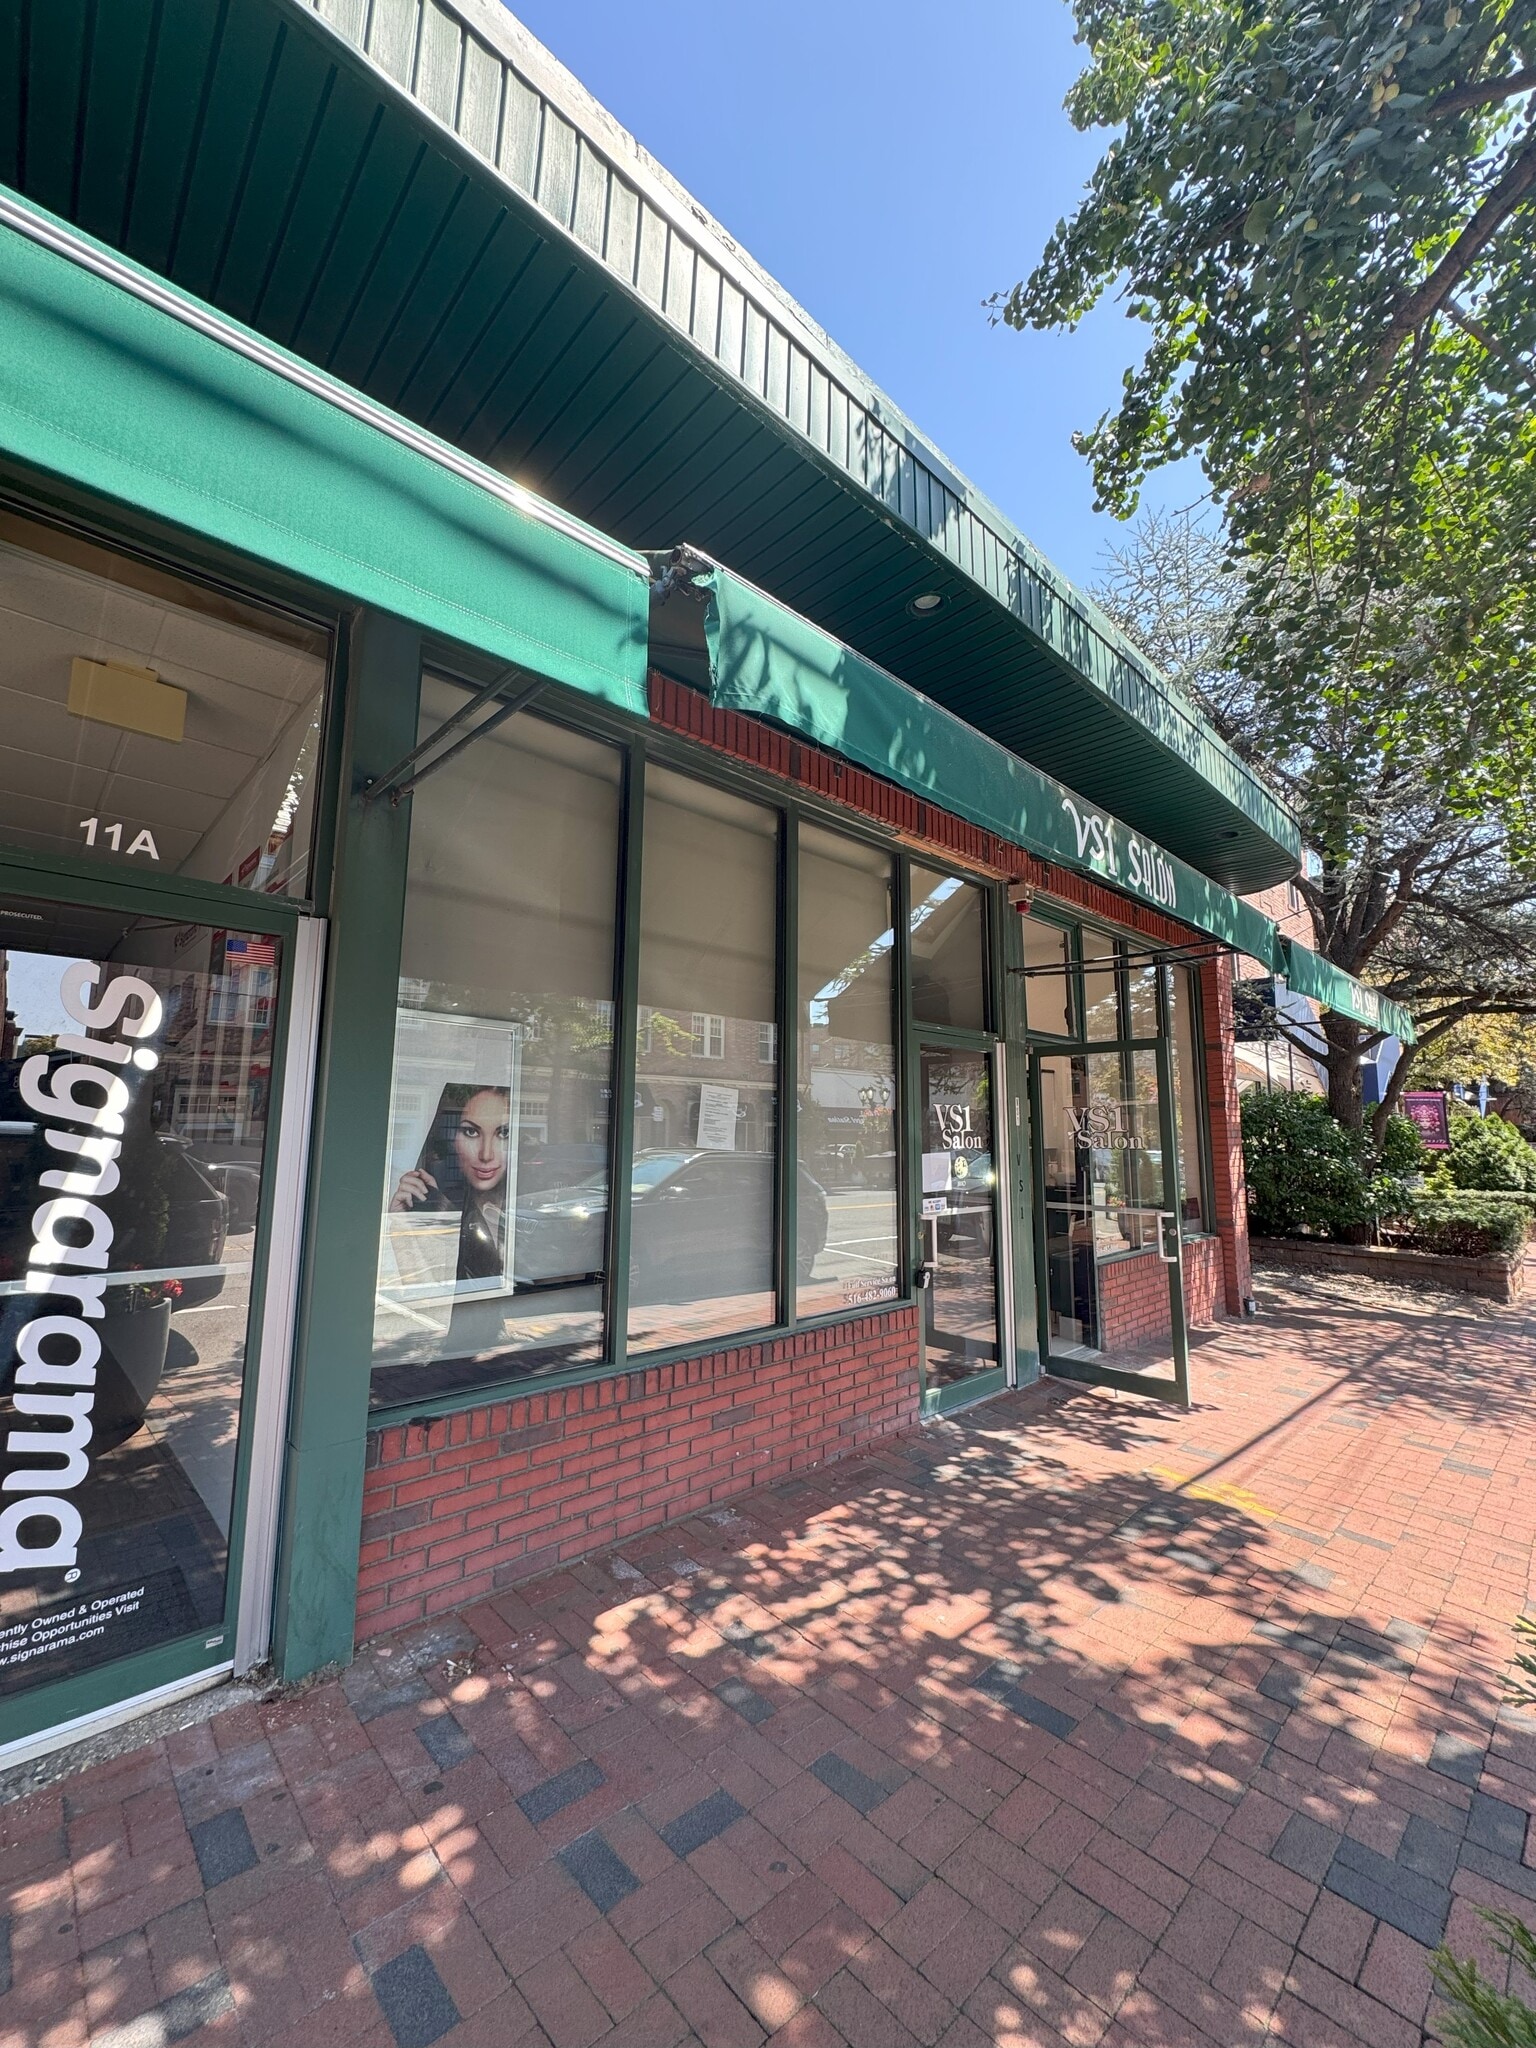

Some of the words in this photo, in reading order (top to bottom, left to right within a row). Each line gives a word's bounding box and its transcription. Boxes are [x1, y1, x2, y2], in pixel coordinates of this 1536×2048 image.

[79, 817, 160, 861] 11A
[1127, 839, 1176, 909] SALON
[0, 909, 44, 921] PROSECUTED.
[932, 1103, 974, 1133] VS1
[1063, 1105, 1128, 1132] VS1
[942, 1129, 983, 1150] Salon
[1077, 1130, 1145, 1150] Salon
[0, 961, 163, 1573] Signarama
[848, 1286, 896, 1304] 516-482-9060
[31, 1607, 76, 1629] Owned
[78, 1604, 88, 1615] &
[91, 1586, 145, 1610] Operated
[31, 1610, 113, 1642] Opportunities
[115, 1601, 140, 1616] Visit
